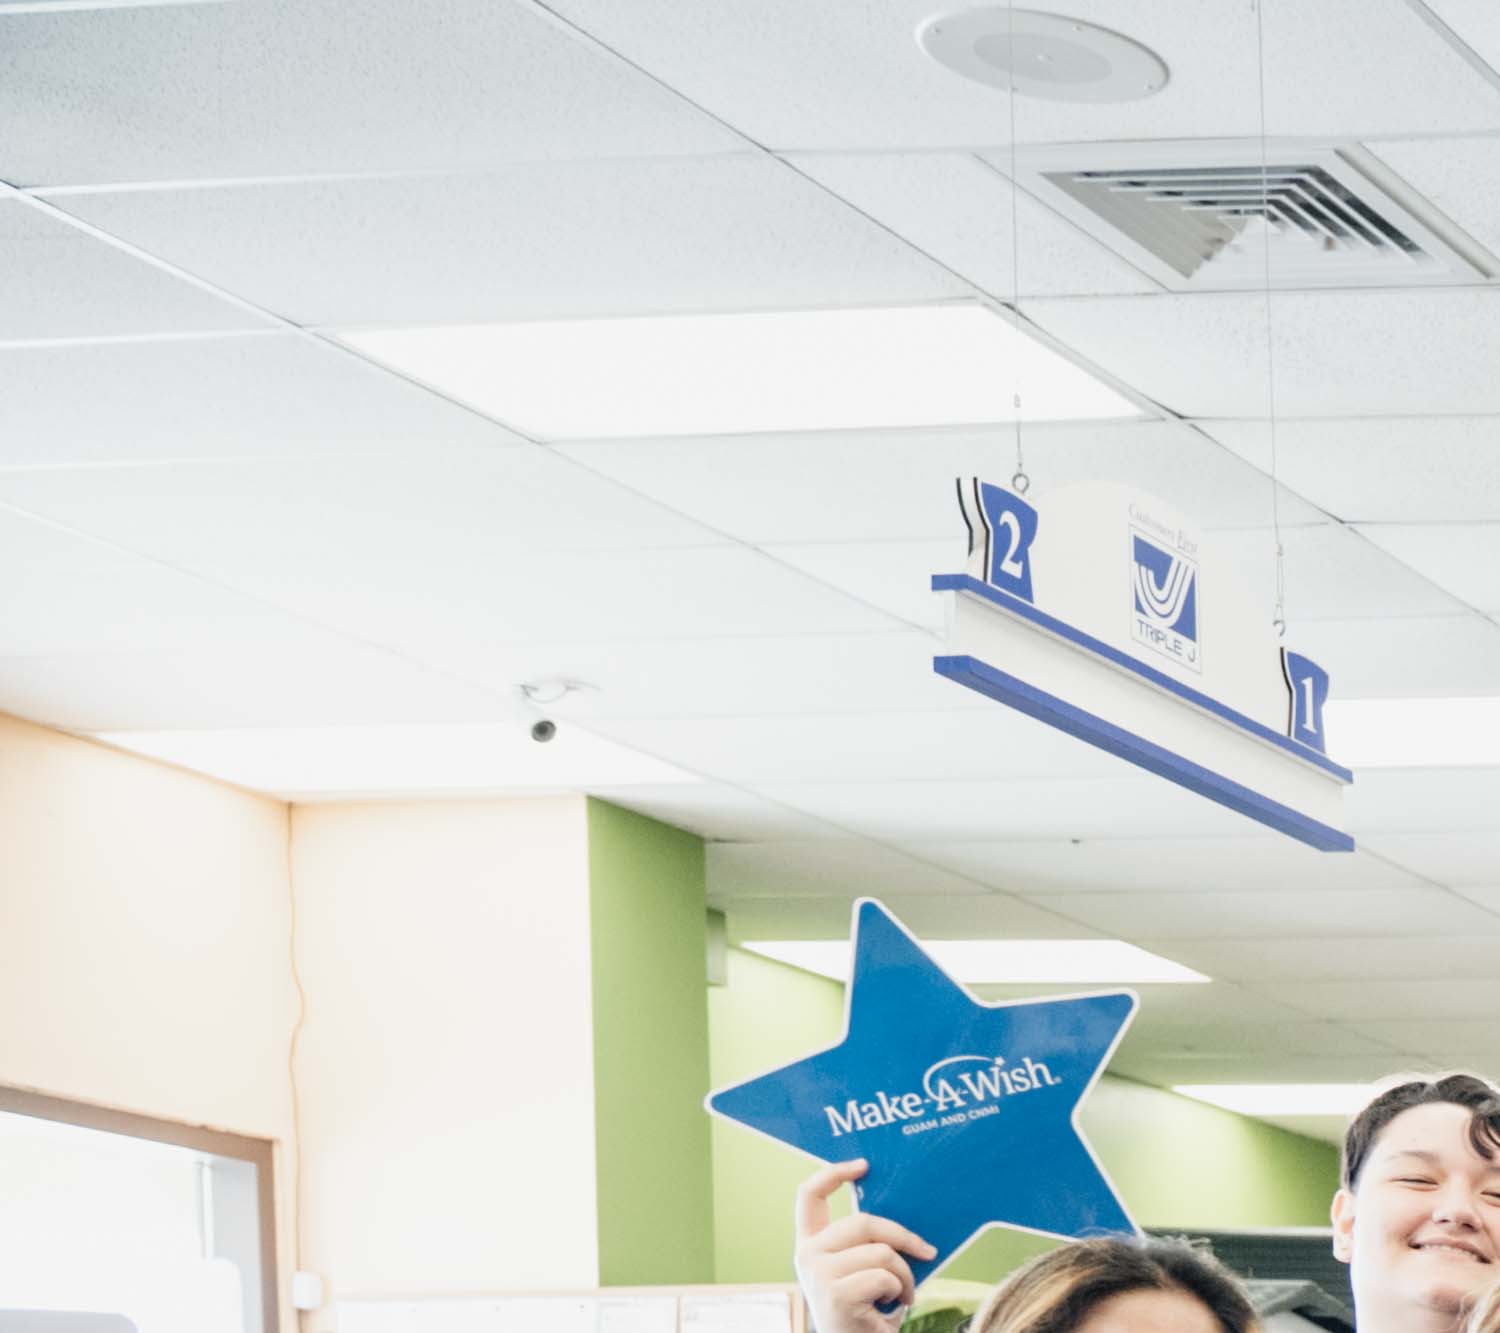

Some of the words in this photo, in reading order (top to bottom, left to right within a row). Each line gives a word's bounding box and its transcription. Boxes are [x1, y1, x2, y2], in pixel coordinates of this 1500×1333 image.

[1000, 510, 1023, 579] 2
[1137, 619, 1182, 656] TRIPLE
[1187, 648, 1197, 663] J
[1300, 677, 1317, 733] 1
[823, 1056, 1062, 1137] Make-A-Wish
[902, 1118, 939, 1136] GUAM
[940, 1111, 966, 1128] AND
[967, 1104, 1000, 1122] CNMI
